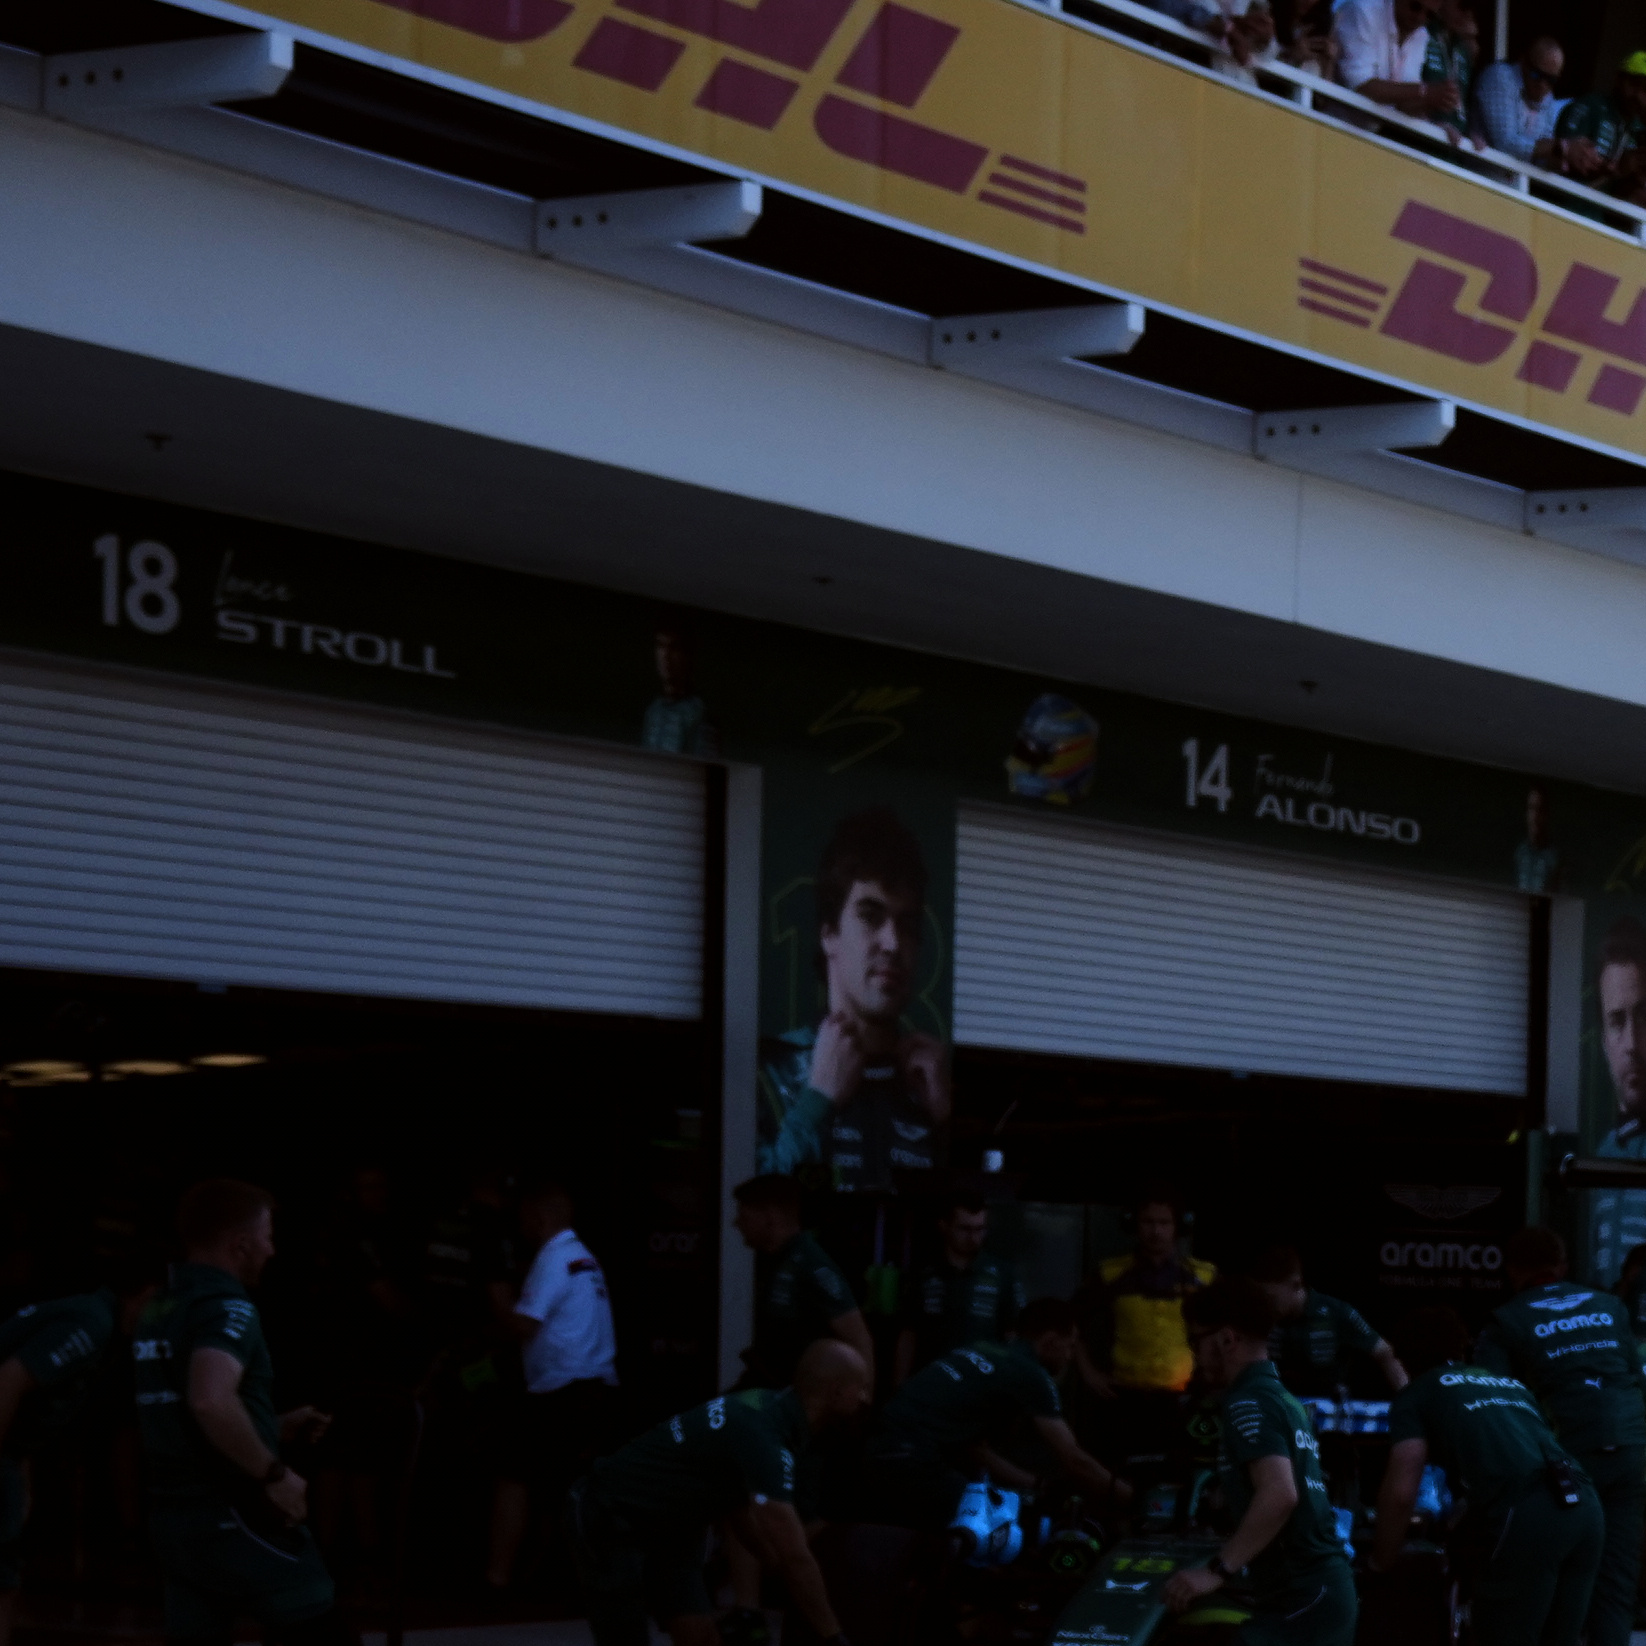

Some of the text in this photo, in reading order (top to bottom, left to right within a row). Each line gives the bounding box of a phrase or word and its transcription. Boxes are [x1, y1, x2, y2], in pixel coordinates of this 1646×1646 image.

[92, 531, 183, 635] 18
[215, 607, 457, 680] STROLL
[1181, 737, 1233, 813] 14
[1254, 793, 1422, 846] ALONSO
[1379, 1241, 1503, 1270] aramco
[1534, 1312, 1614, 1339] aramco
